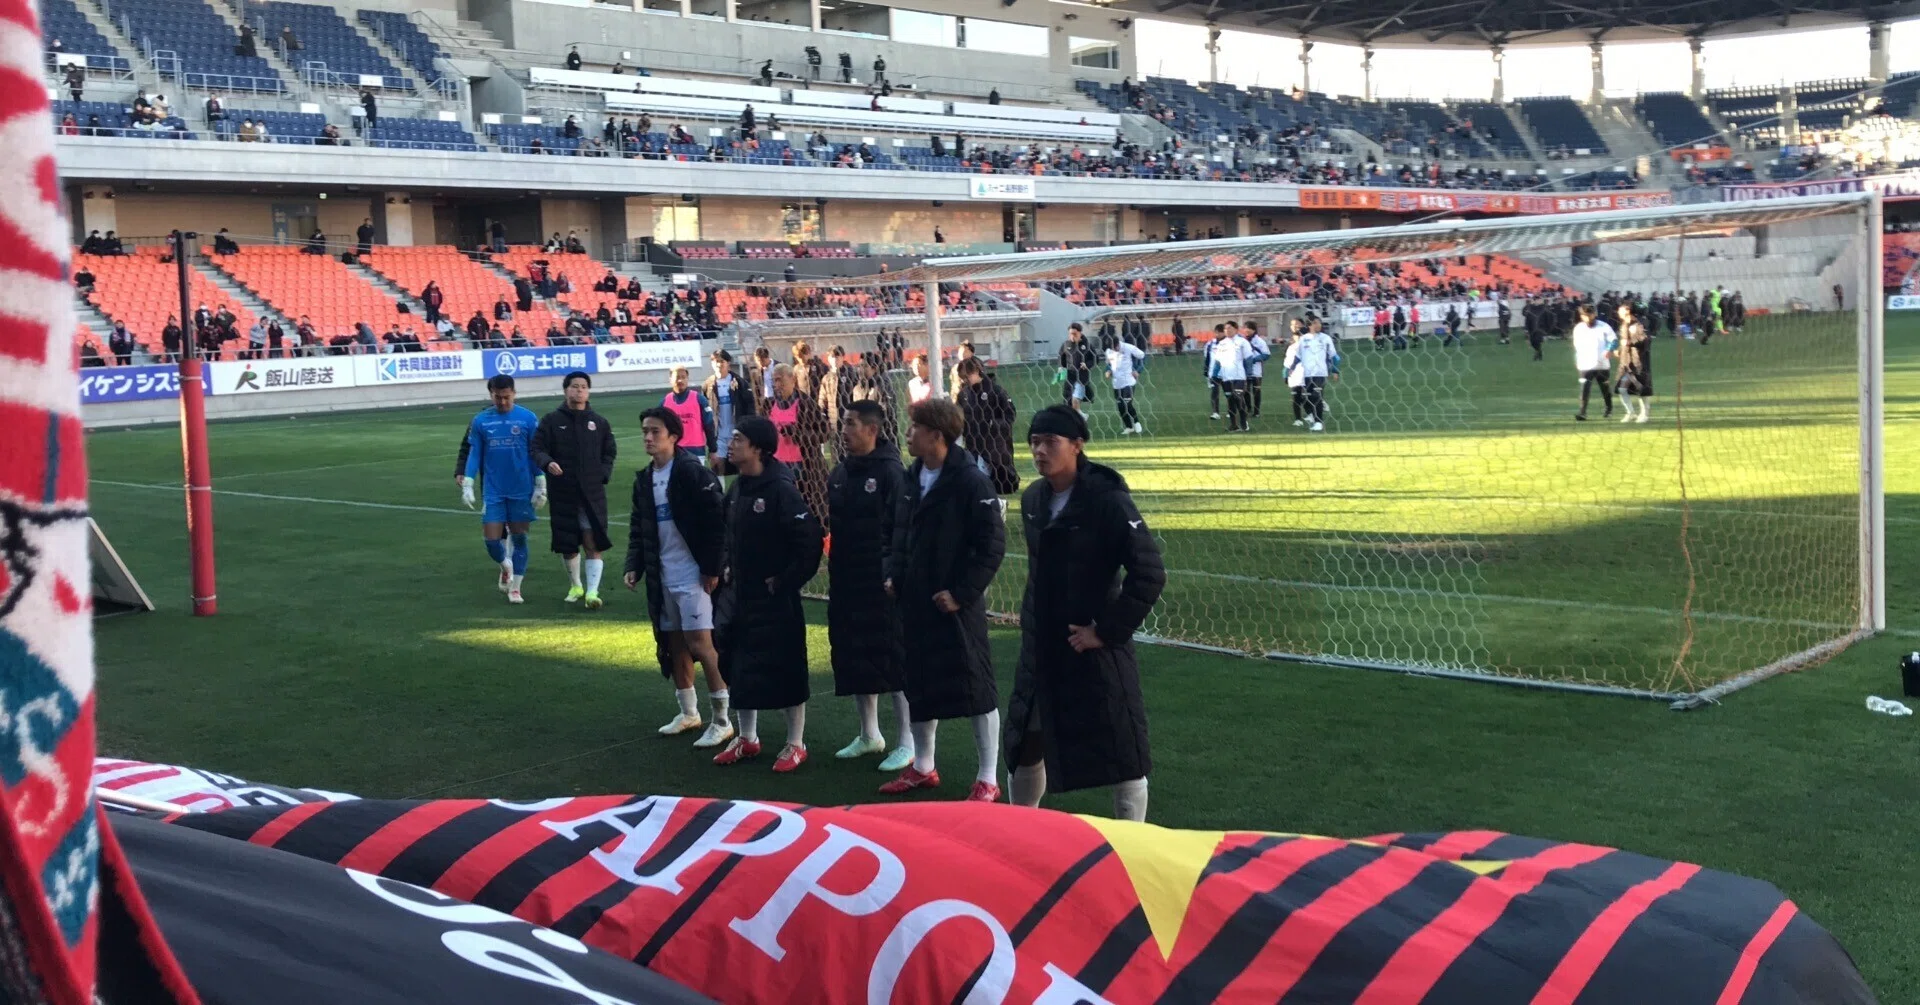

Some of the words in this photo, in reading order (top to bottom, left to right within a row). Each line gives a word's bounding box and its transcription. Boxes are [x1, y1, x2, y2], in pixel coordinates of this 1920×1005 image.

[398, 355, 463, 372] 共同建設設計
[518, 352, 587, 371] 富士印刷
[622, 355, 694, 366] TAKAMISAWA
[265, 366, 334, 388] 飯山陸送
[486, 795, 1116, 1005] APPO
